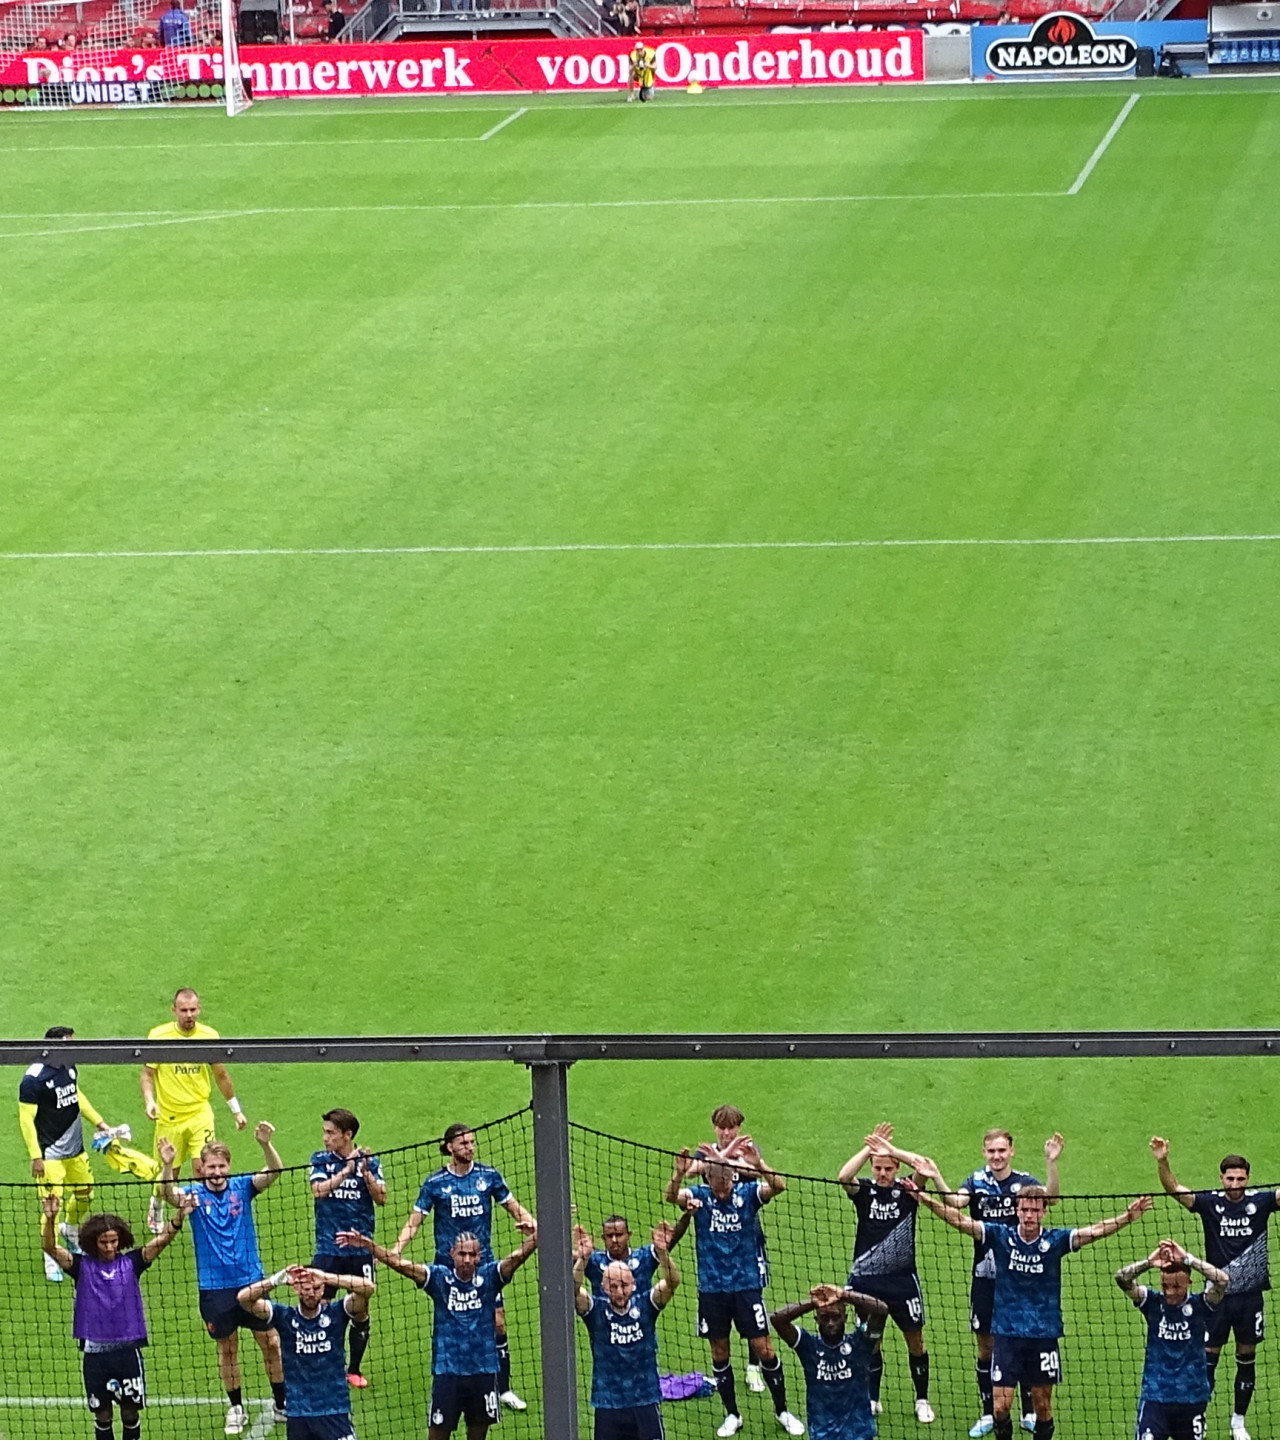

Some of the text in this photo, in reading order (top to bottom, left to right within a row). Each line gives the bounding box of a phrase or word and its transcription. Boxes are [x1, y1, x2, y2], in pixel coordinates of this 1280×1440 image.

[656, 37, 914, 83] Onderhoud
[995, 41, 1129, 68] NAPOLEON
[70, 80, 153, 103] UNIBET
[55, 1083, 76, 1099] Euro
[450, 1194, 480, 1207] Euro
[451, 1205, 484, 1218] Parcs
[869, 1207, 900, 1220] Parcs
[1220, 1226, 1253, 1237] Parcs
[1010, 1248, 1041, 1263] Euro
[1008, 1259, 1044, 1273] Parcs
[449, 1286, 478, 1301] Euro
[447, 1297, 481, 1312] Parcs
[295, 1340, 331, 1354] Parcs
[1039, 1351, 1058, 1371] 20
[122, 1376, 142, 1396] 24
